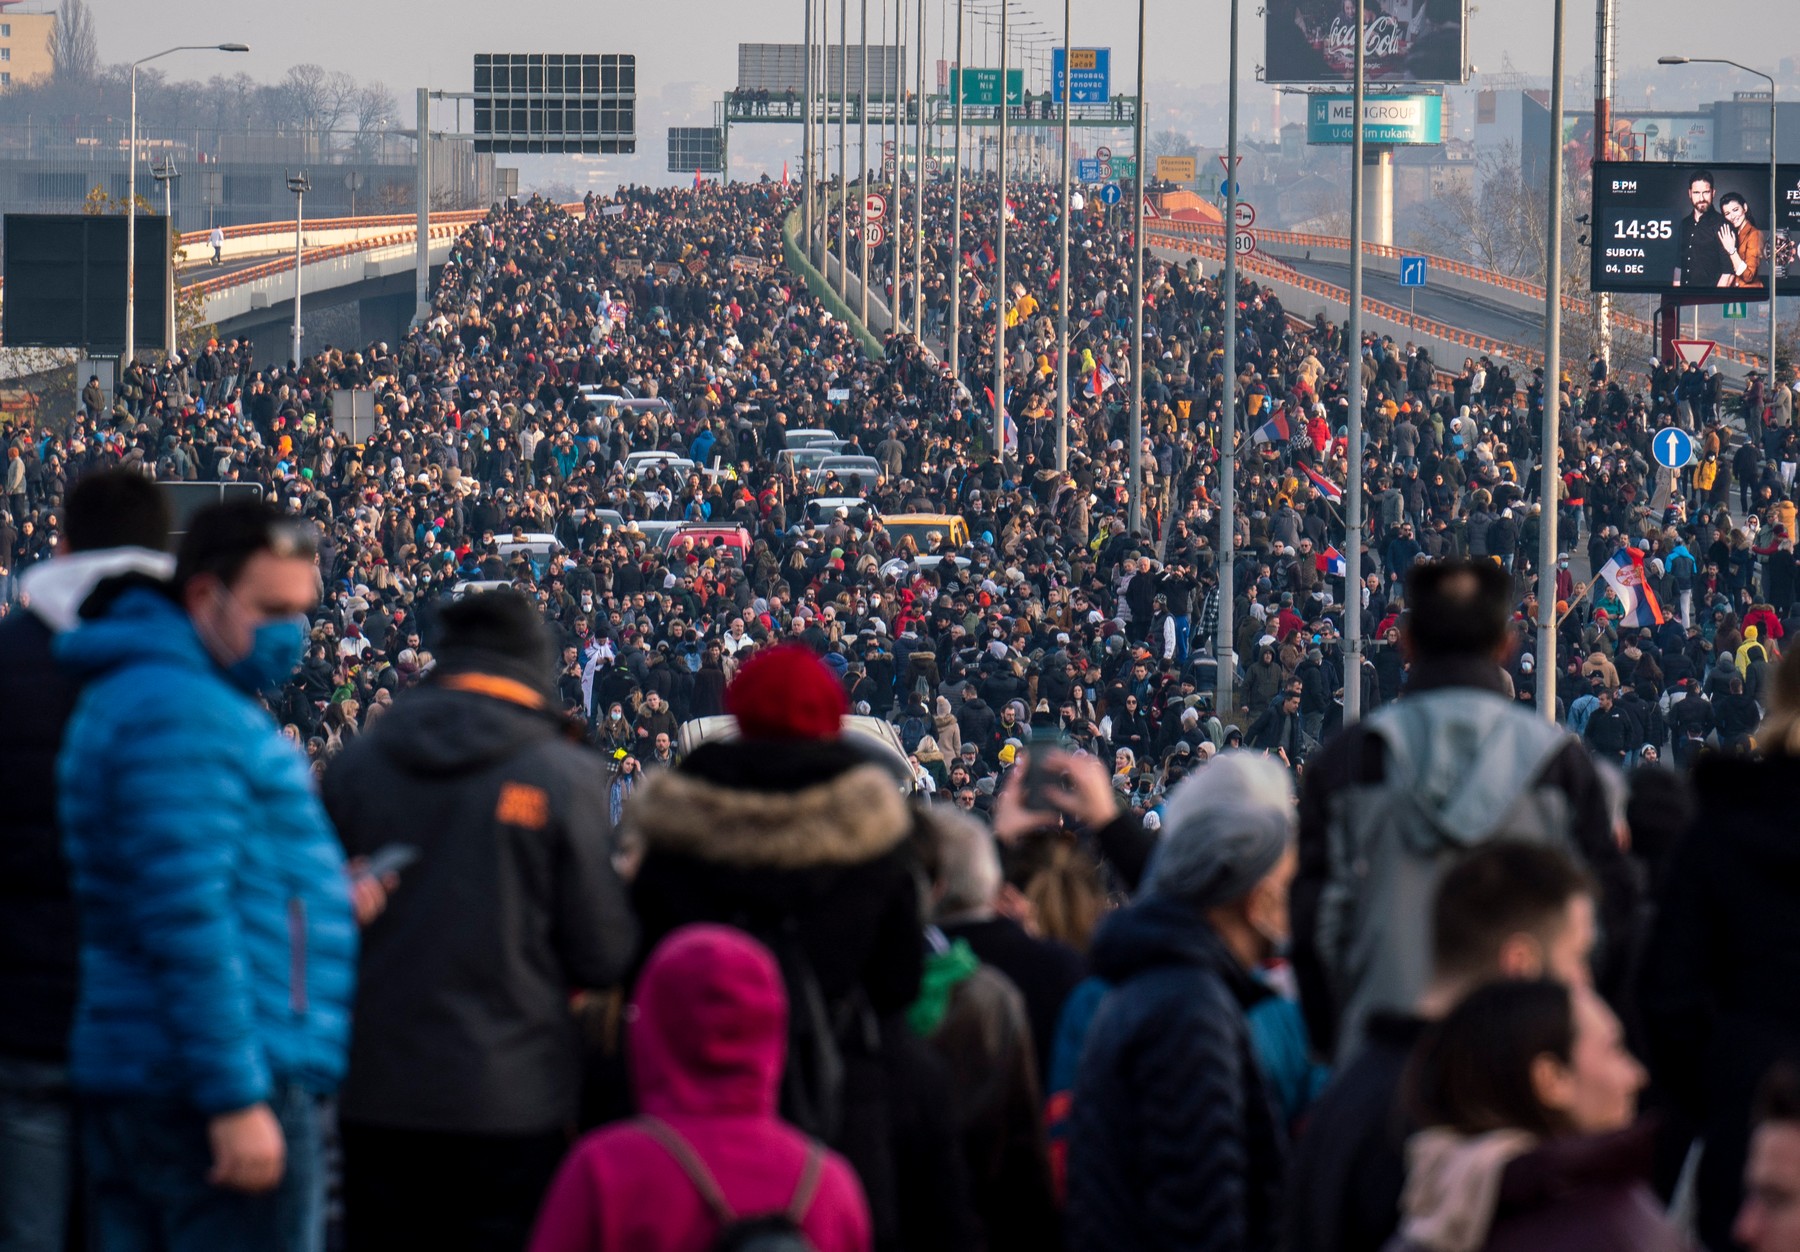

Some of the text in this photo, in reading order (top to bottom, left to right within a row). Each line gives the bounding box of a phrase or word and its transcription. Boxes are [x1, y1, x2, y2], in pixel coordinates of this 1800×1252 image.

[1057, 71, 1105, 80] Оеновац
[1059, 80, 1103, 88] Orenovac
[1333, 106, 1415, 119] MEIGROUP
[1332, 129, 1339, 138] U
[1342, 128, 1377, 138] doim
[1614, 220, 1672, 239] 14:35
[1235, 236, 1251, 250] 80
[1606, 248, 1645, 257] SUBOTA
[1605, 264, 1644, 273] 04. DEC
